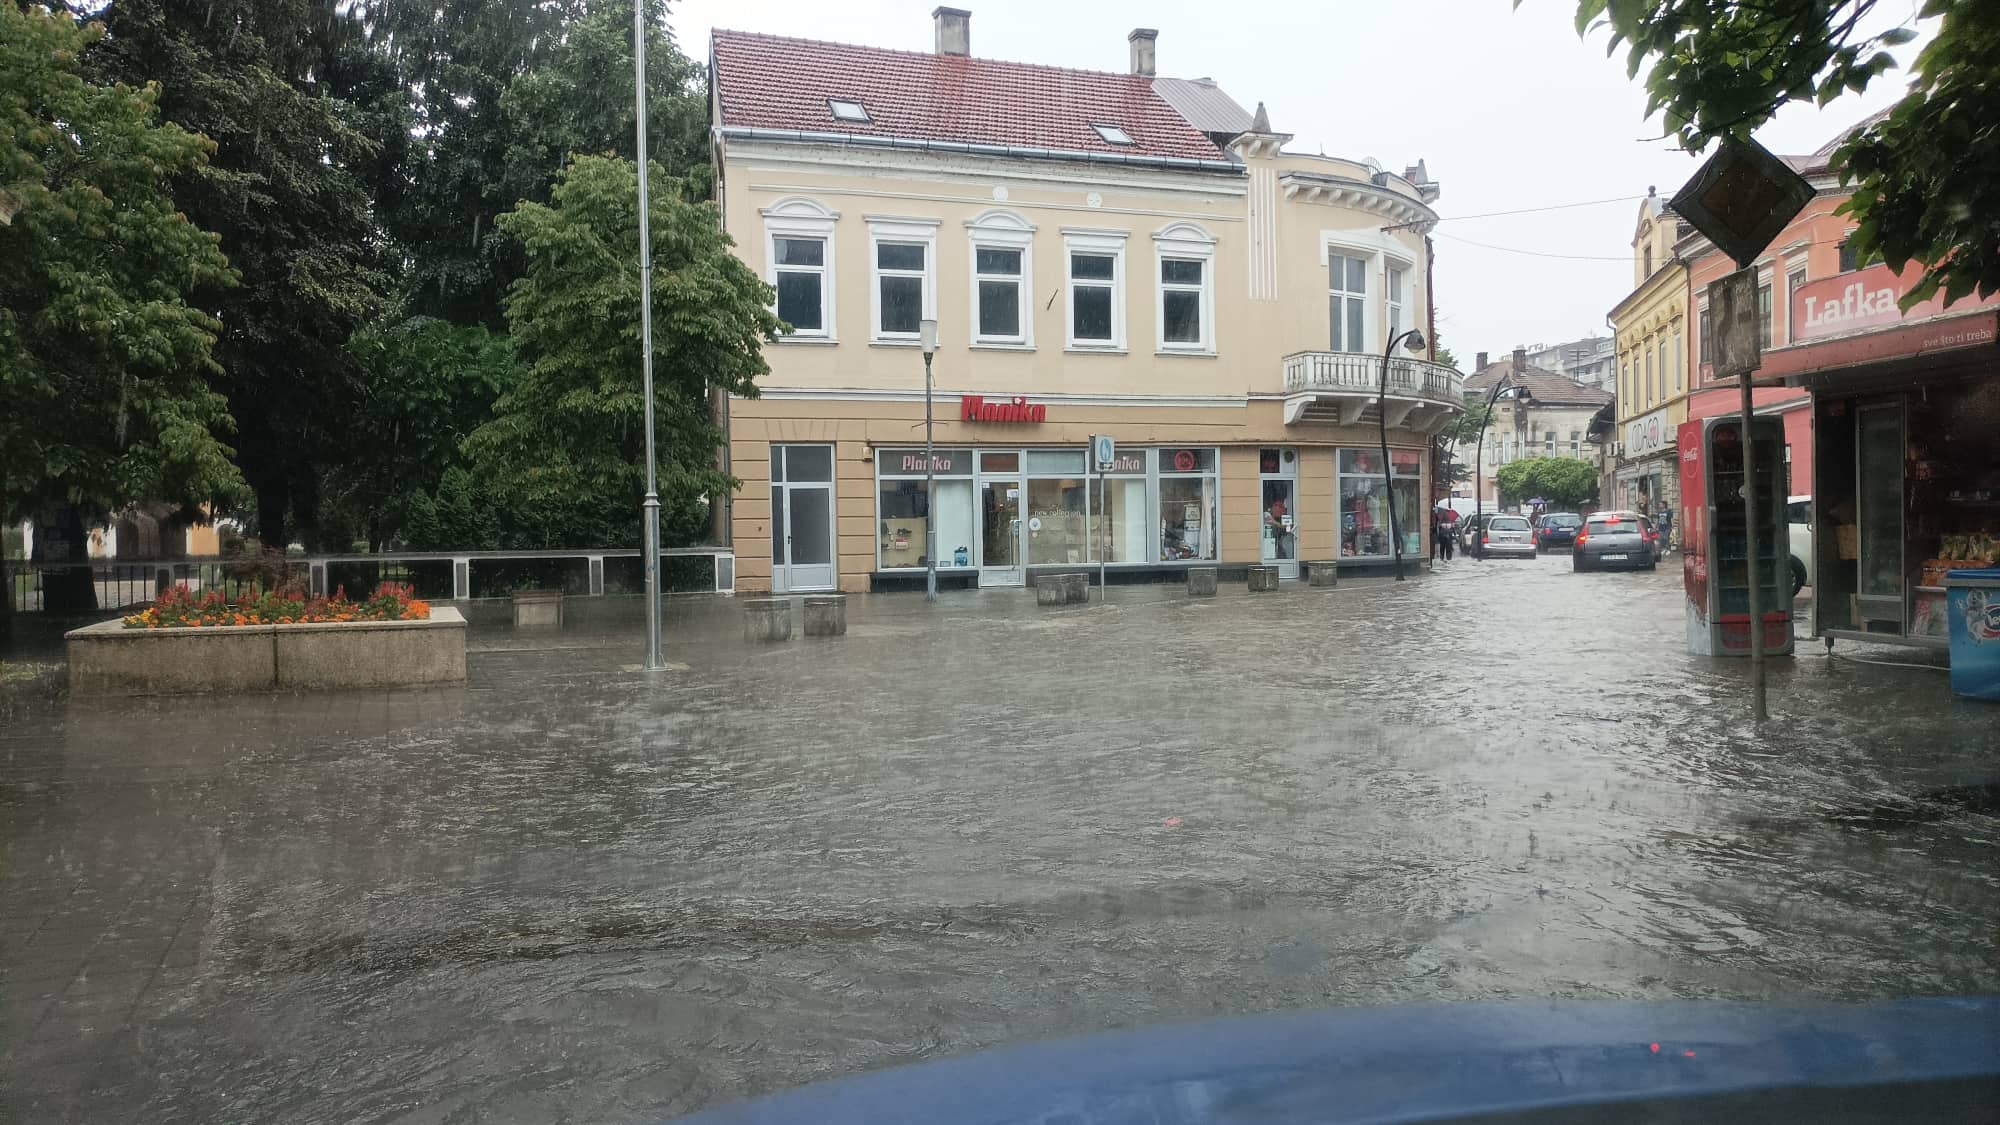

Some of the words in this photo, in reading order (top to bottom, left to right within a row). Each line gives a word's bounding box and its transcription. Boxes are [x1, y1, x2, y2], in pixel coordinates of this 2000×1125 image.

[1804, 282, 1899, 329] Lafka
[1923, 339, 1938, 348] sve
[1966, 328, 1992, 341] treba
[962, 394, 1046, 423] Planika
